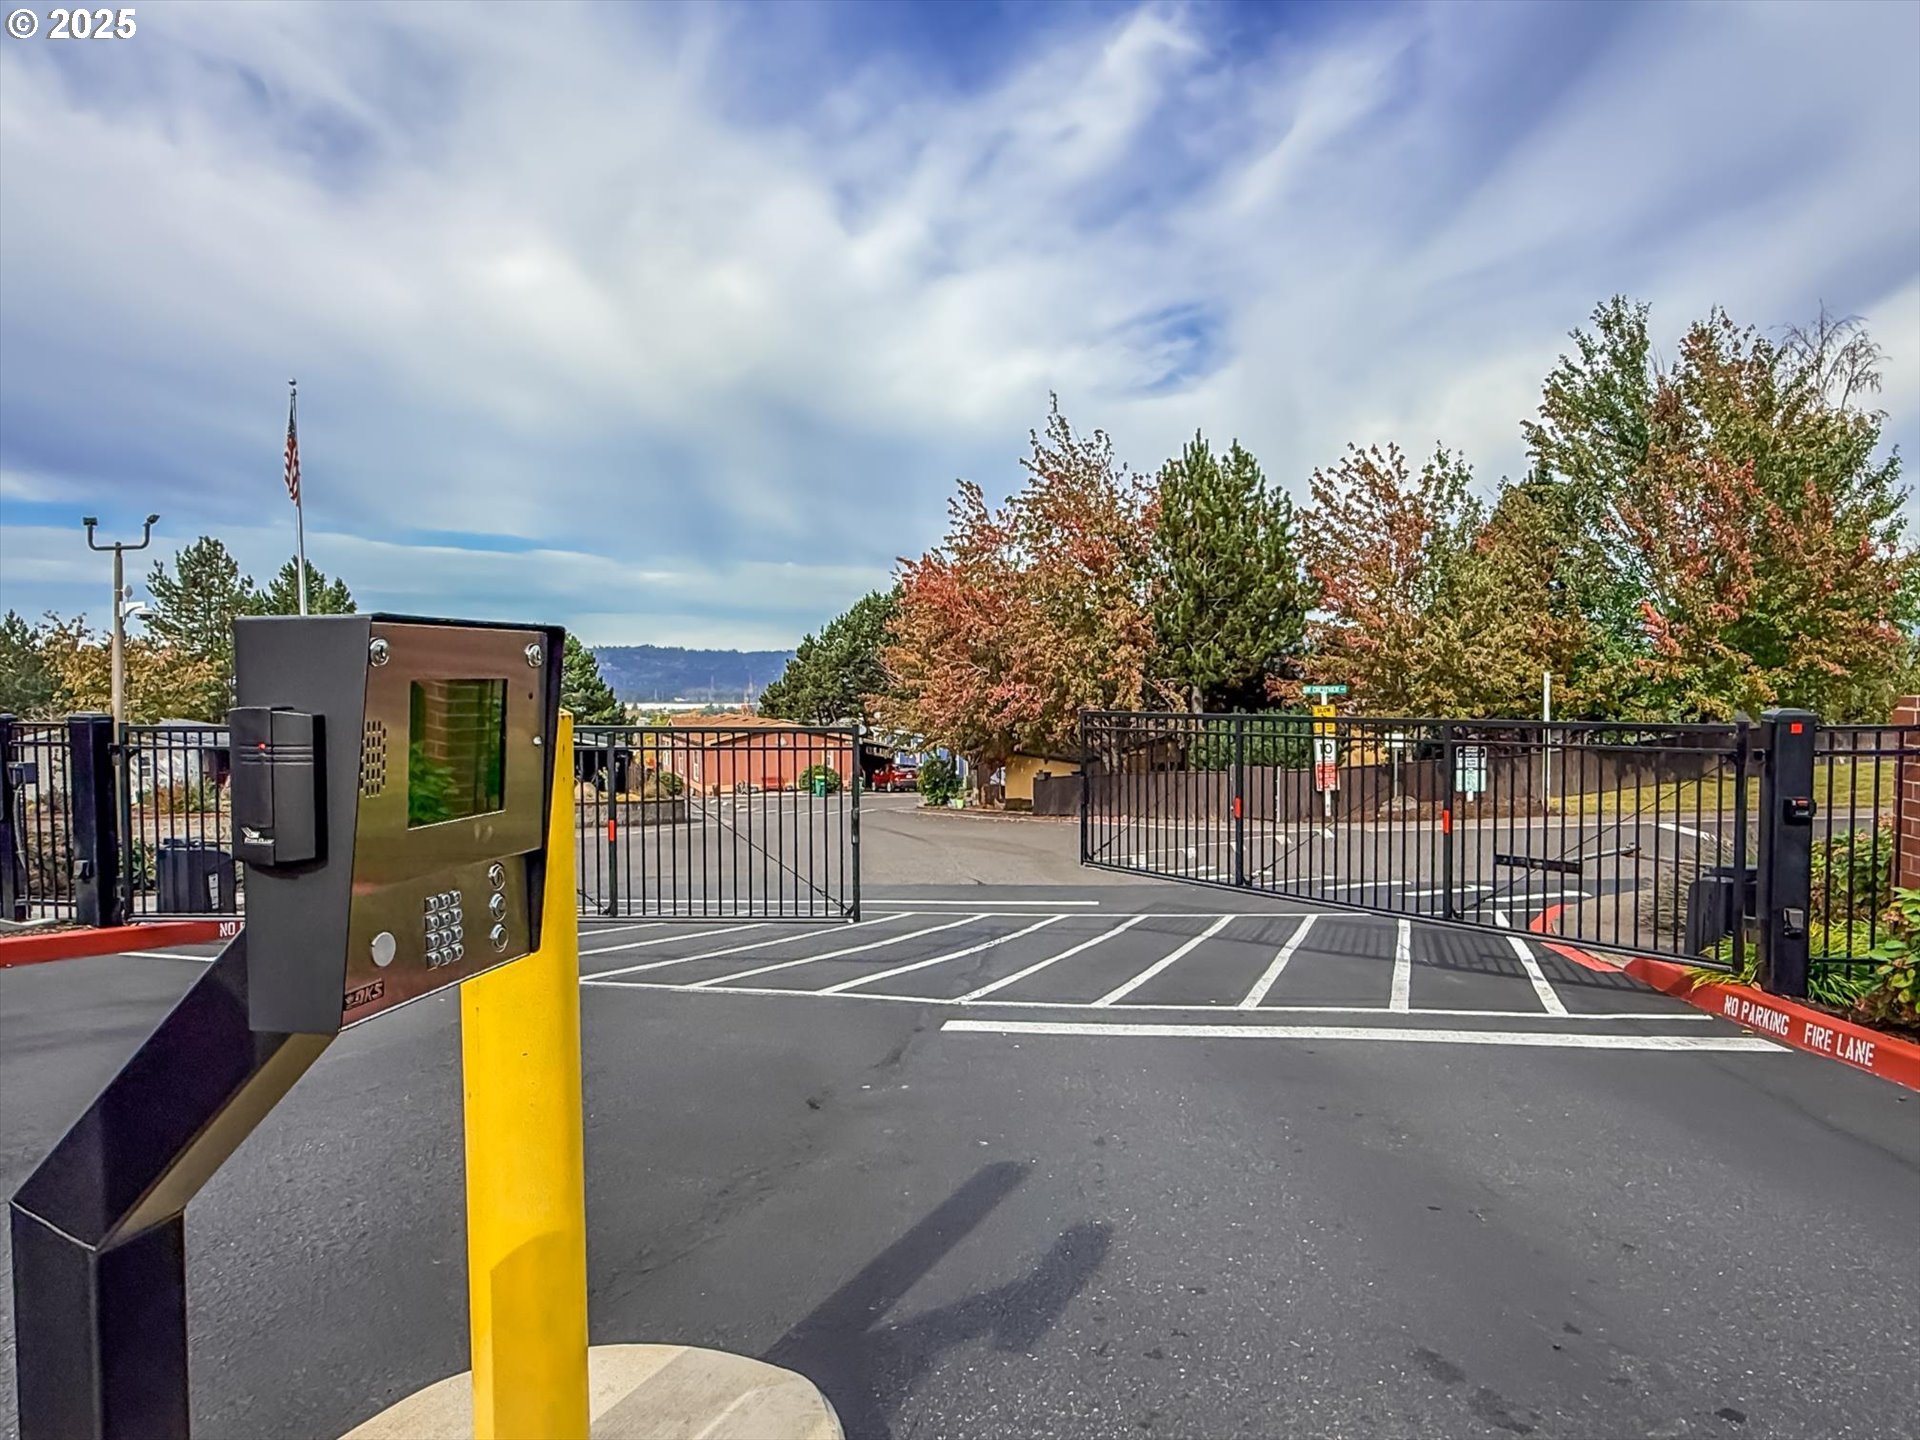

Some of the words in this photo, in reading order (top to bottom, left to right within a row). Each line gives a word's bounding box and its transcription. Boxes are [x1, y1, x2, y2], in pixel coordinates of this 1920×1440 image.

[220, 921, 236, 937] NO
[1724, 995, 1739, 1017] NO
[1741, 1001, 1790, 1036] PARKING
[1804, 1022, 1834, 1052] FIRE
[1836, 1033, 1875, 1067] LANE
